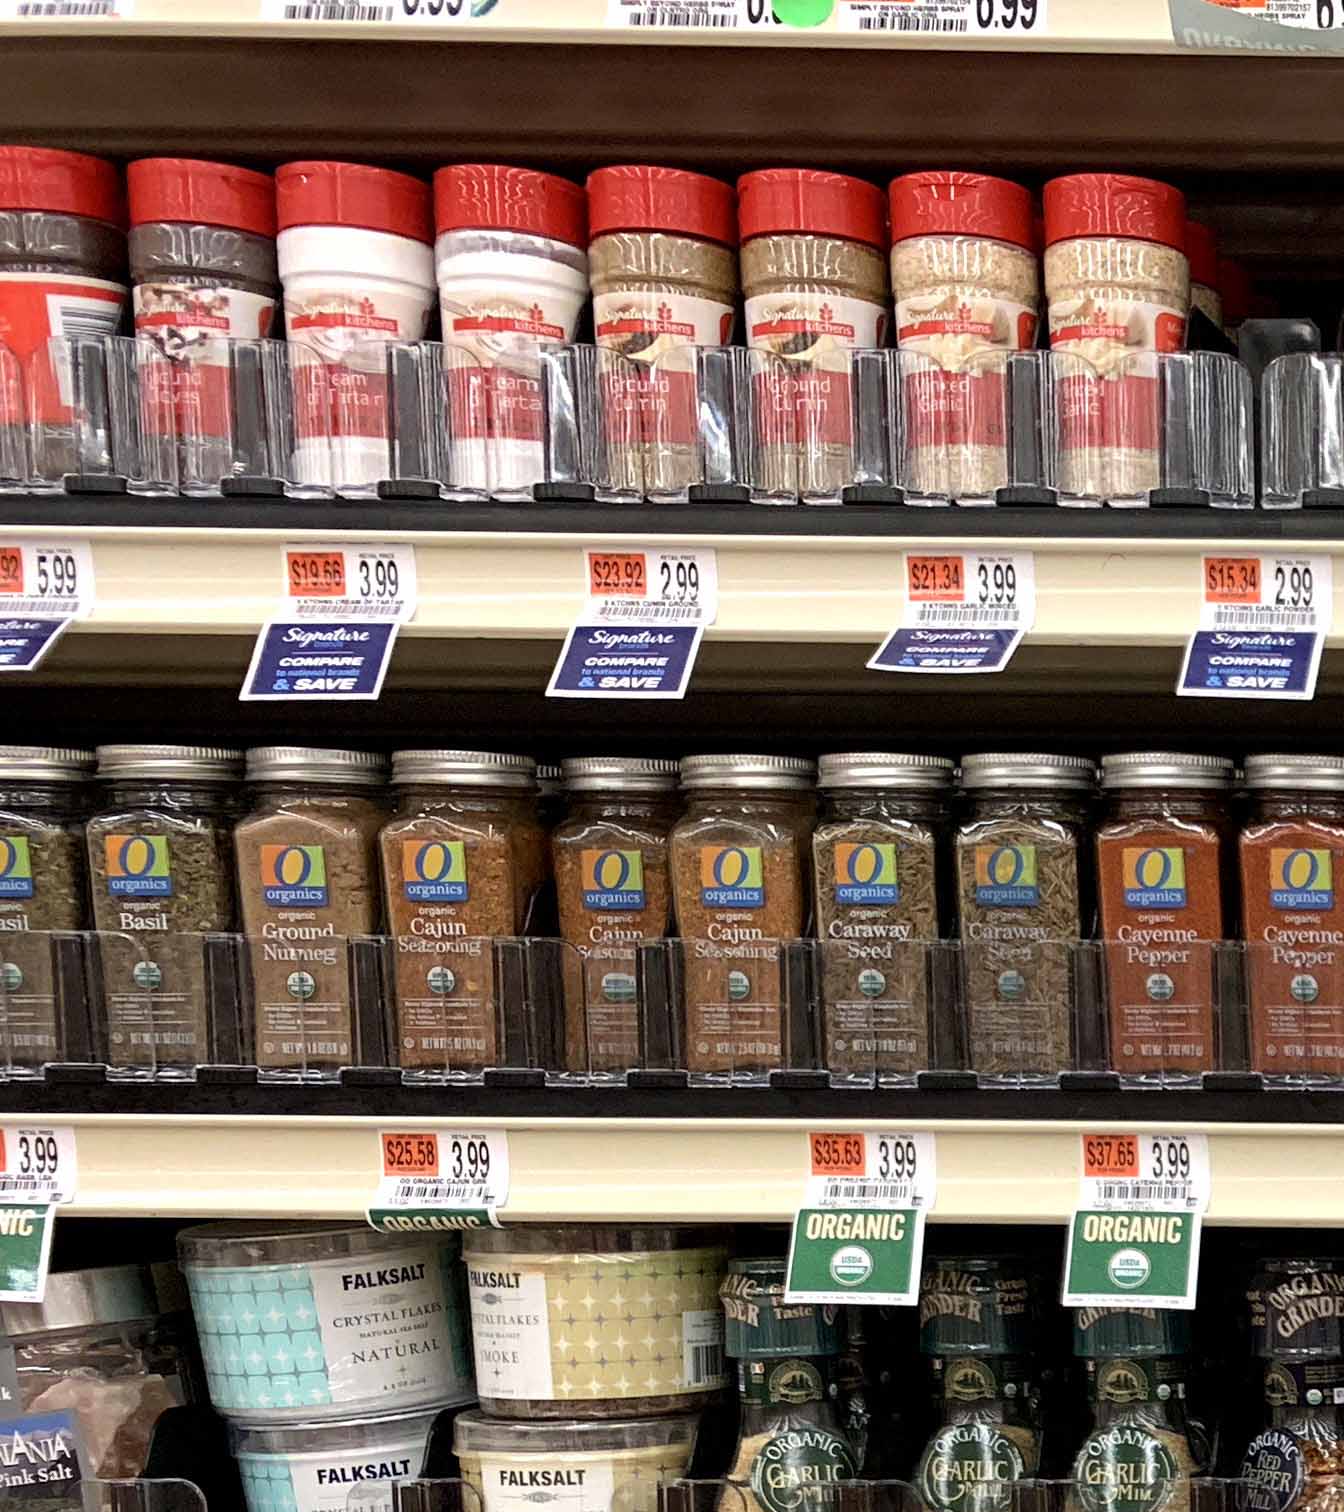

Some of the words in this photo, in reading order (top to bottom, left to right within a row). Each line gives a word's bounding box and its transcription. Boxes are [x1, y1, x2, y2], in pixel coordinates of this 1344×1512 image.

[290, 559, 343, 588] $19.66
[359, 561, 399, 597] 3.99
[592, 560, 643, 588] $23.92
[660, 562, 699, 601] 2.99
[120, 911, 168, 931] Basil
[262, 922, 333, 941] Ground
[410, 919, 466, 938] Cajun
[829, 922, 910, 944] Caraway
[1118, 927, 1197, 946] Cayenne
[386, 1140, 434, 1168] $25.58
[452, 1141, 489, 1179] 3.99
[812, 1139, 862, 1166] $35.63
[878, 1142, 916, 1178] 3.99
[1083, 1217, 1182, 1243] ORGANIC
[342, 1263, 426, 1291] FALKSALT
[333, 1312, 397, 1330] CRYSTAL
[400, 1301, 444, 1322] FLAKES
[352, 1339, 441, 1364] NATURAL
[499, 1470, 585, 1487] FALKSALT
